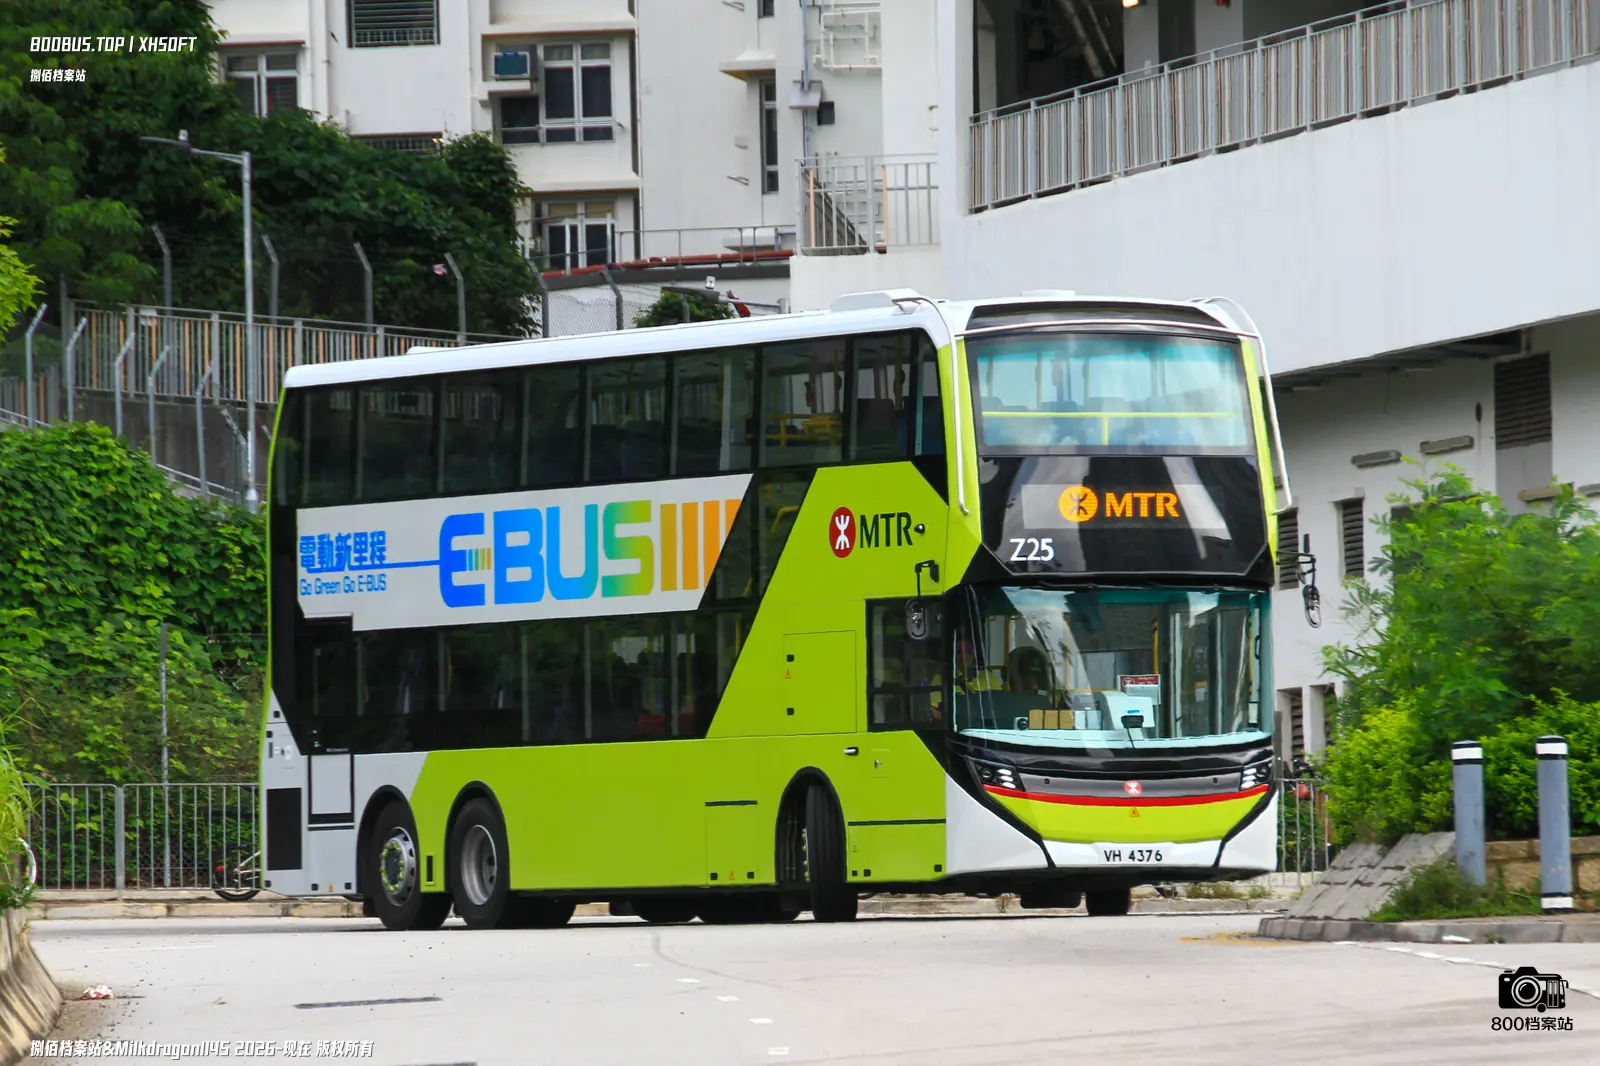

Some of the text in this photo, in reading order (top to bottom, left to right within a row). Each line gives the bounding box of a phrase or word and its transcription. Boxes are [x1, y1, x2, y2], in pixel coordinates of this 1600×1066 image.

[1105, 492, 1180, 518] MTR
[859, 511, 913, 548] MTR
[299, 530, 386, 573] 電動新里程
[1010, 538, 1054, 561] Z25
[300, 573, 387, 595] Go Green Go E-BUS
[1104, 850, 1163, 862] VH 4376
